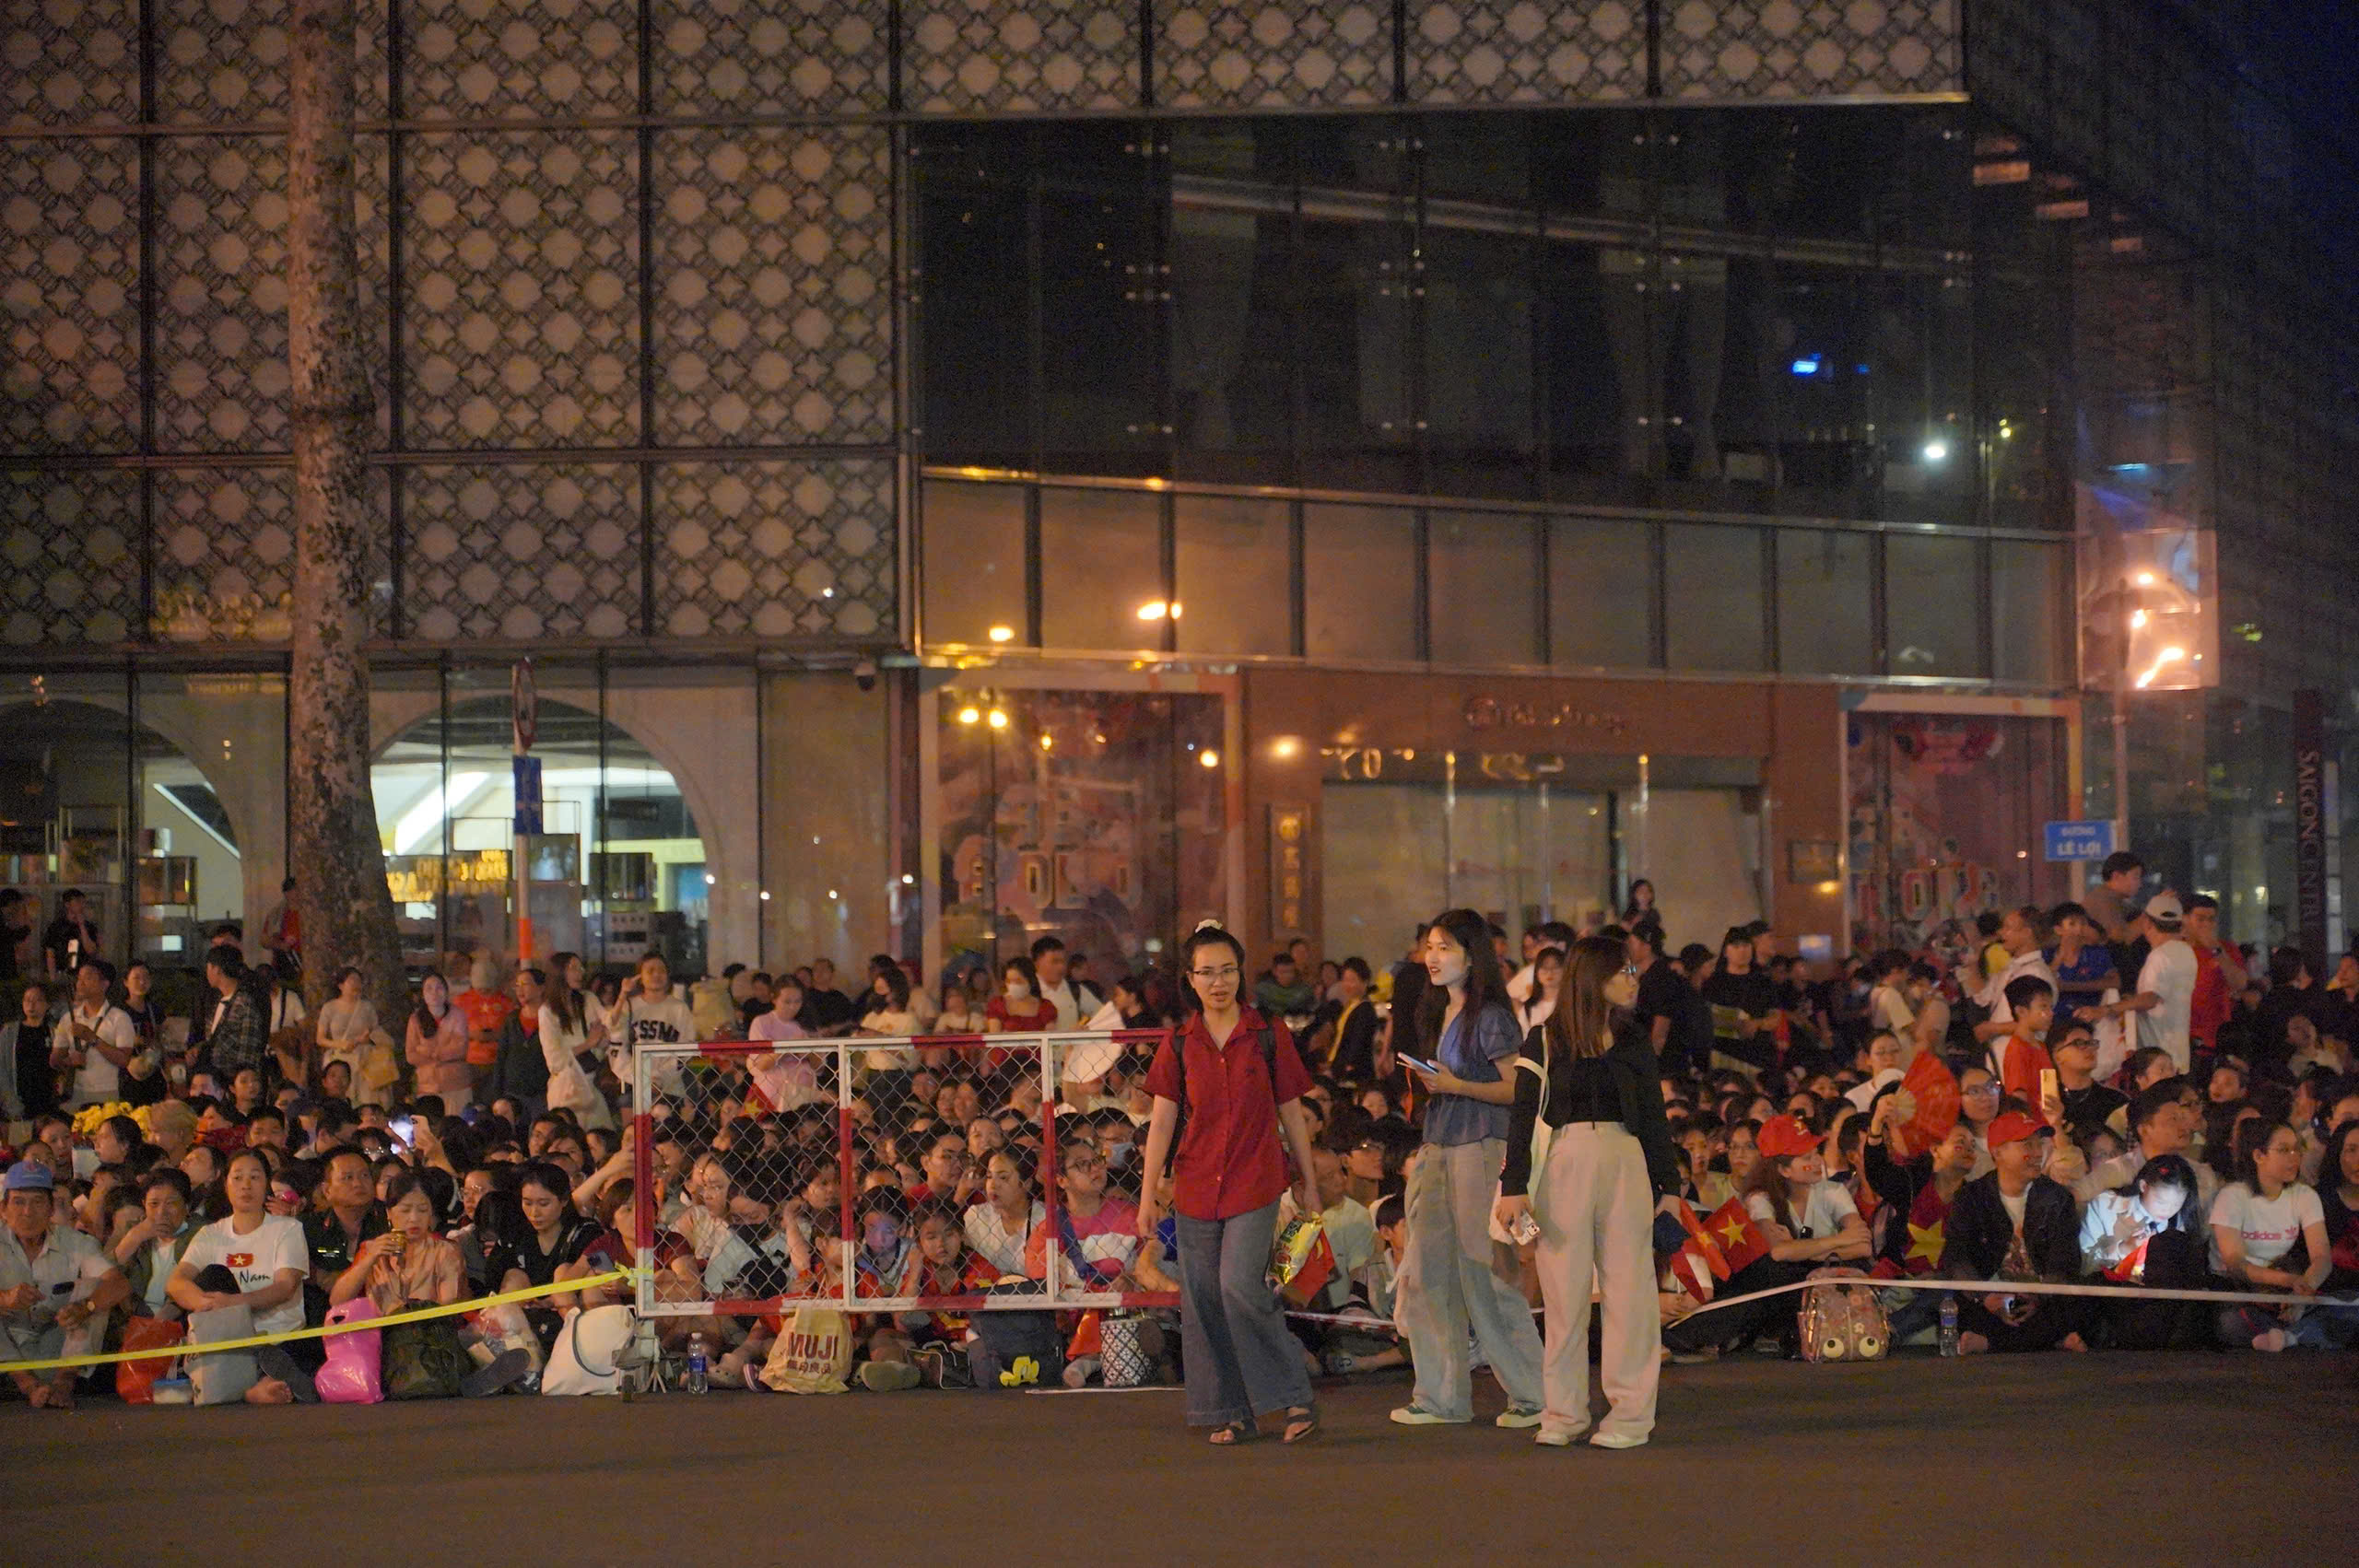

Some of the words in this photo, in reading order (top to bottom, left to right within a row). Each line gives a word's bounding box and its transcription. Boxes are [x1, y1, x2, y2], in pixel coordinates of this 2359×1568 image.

[2297, 750, 2321, 839] SAIGON
[2240, 1229, 2283, 1241] adidas
[240, 1269, 270, 1285] Nam
[788, 1331, 839, 1361] MUJI
